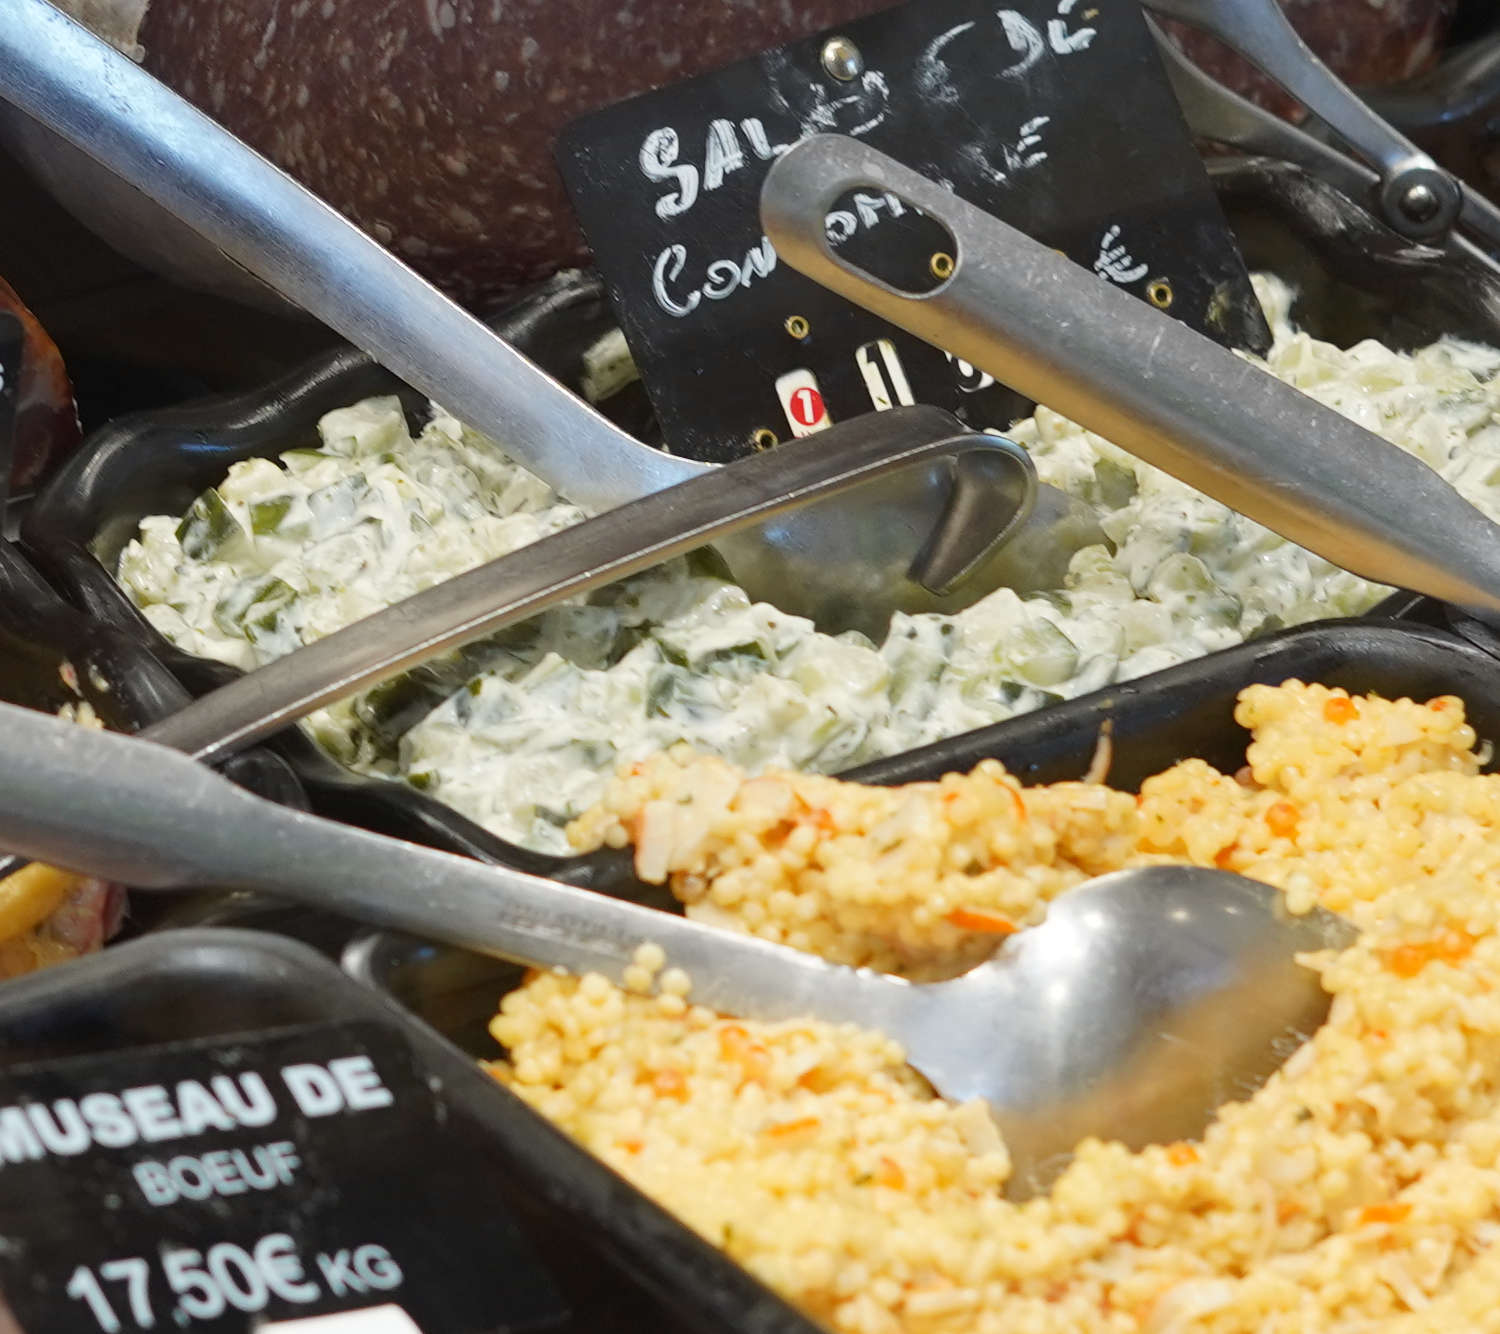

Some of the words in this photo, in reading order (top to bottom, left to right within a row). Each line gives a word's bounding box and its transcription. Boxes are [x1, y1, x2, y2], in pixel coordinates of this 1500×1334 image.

[281, 1054, 394, 1119] DE
[132, 1139, 301, 1207] BOEUF
[66, 1232, 321, 1334] 17,50€
[318, 1243, 405, 1298] KG
